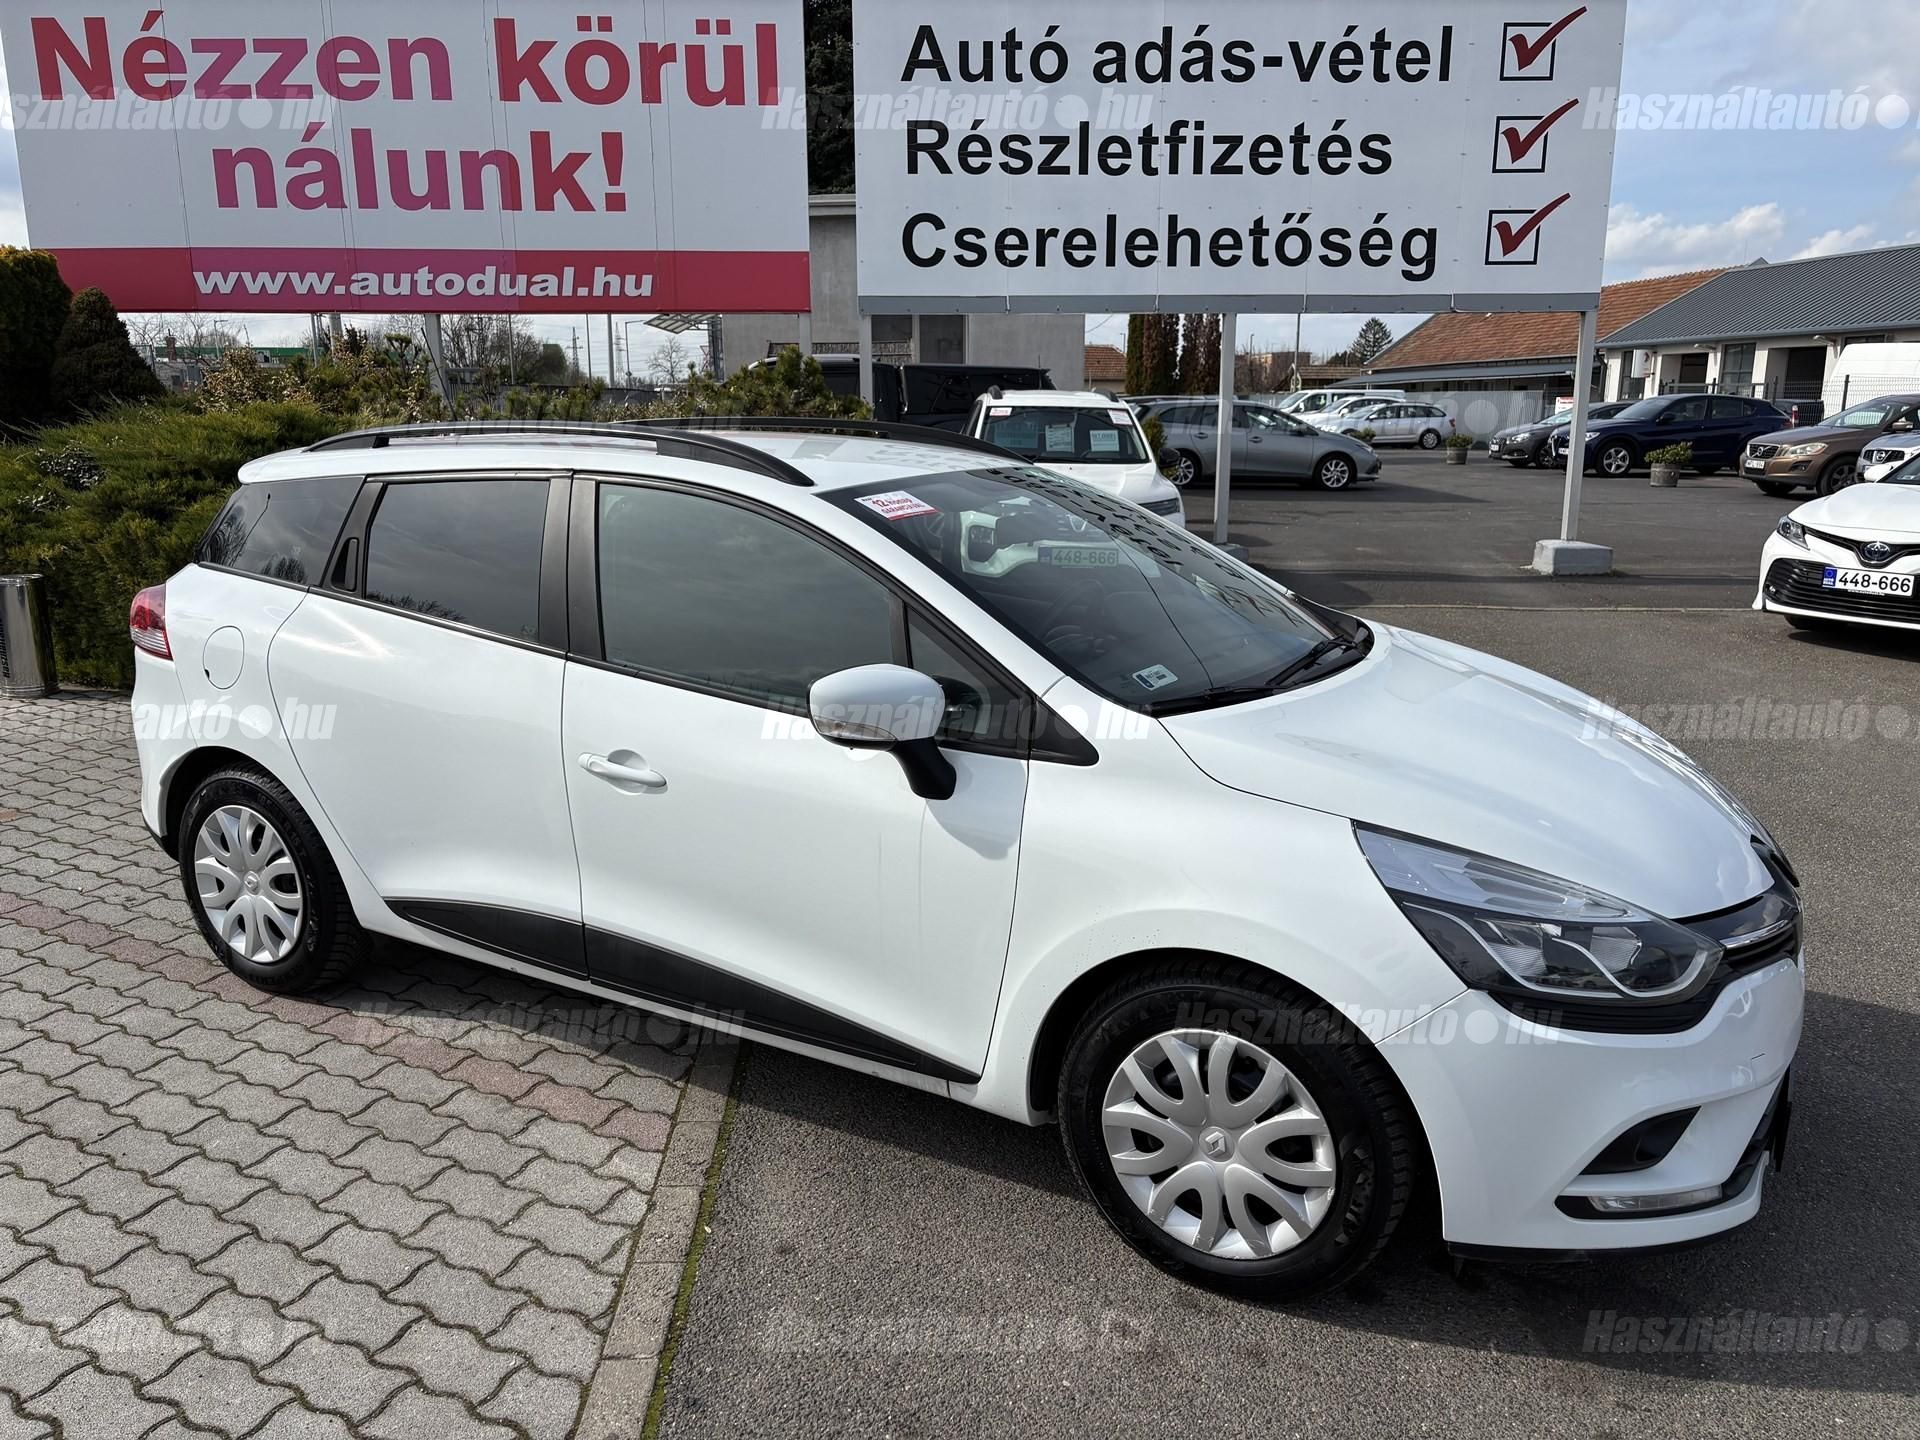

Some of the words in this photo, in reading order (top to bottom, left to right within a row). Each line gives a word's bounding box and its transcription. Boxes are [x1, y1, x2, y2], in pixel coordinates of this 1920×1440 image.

[32, 11, 452, 101] Nézzen
[494, 16, 779, 107] körül
[900, 24, 1069, 84] Autó
[1092, 24, 1453, 84] adás-vétel
[213, 122, 627, 212] nálunk!
[906, 118, 1392, 177] Részletfizetés
[902, 212, 1438, 282] Cserelehetőség
[193, 265, 653, 297] www.autodual.hu
[1053, 550, 1116, 565] 448-666
[1838, 571, 1911, 593] 448-666
